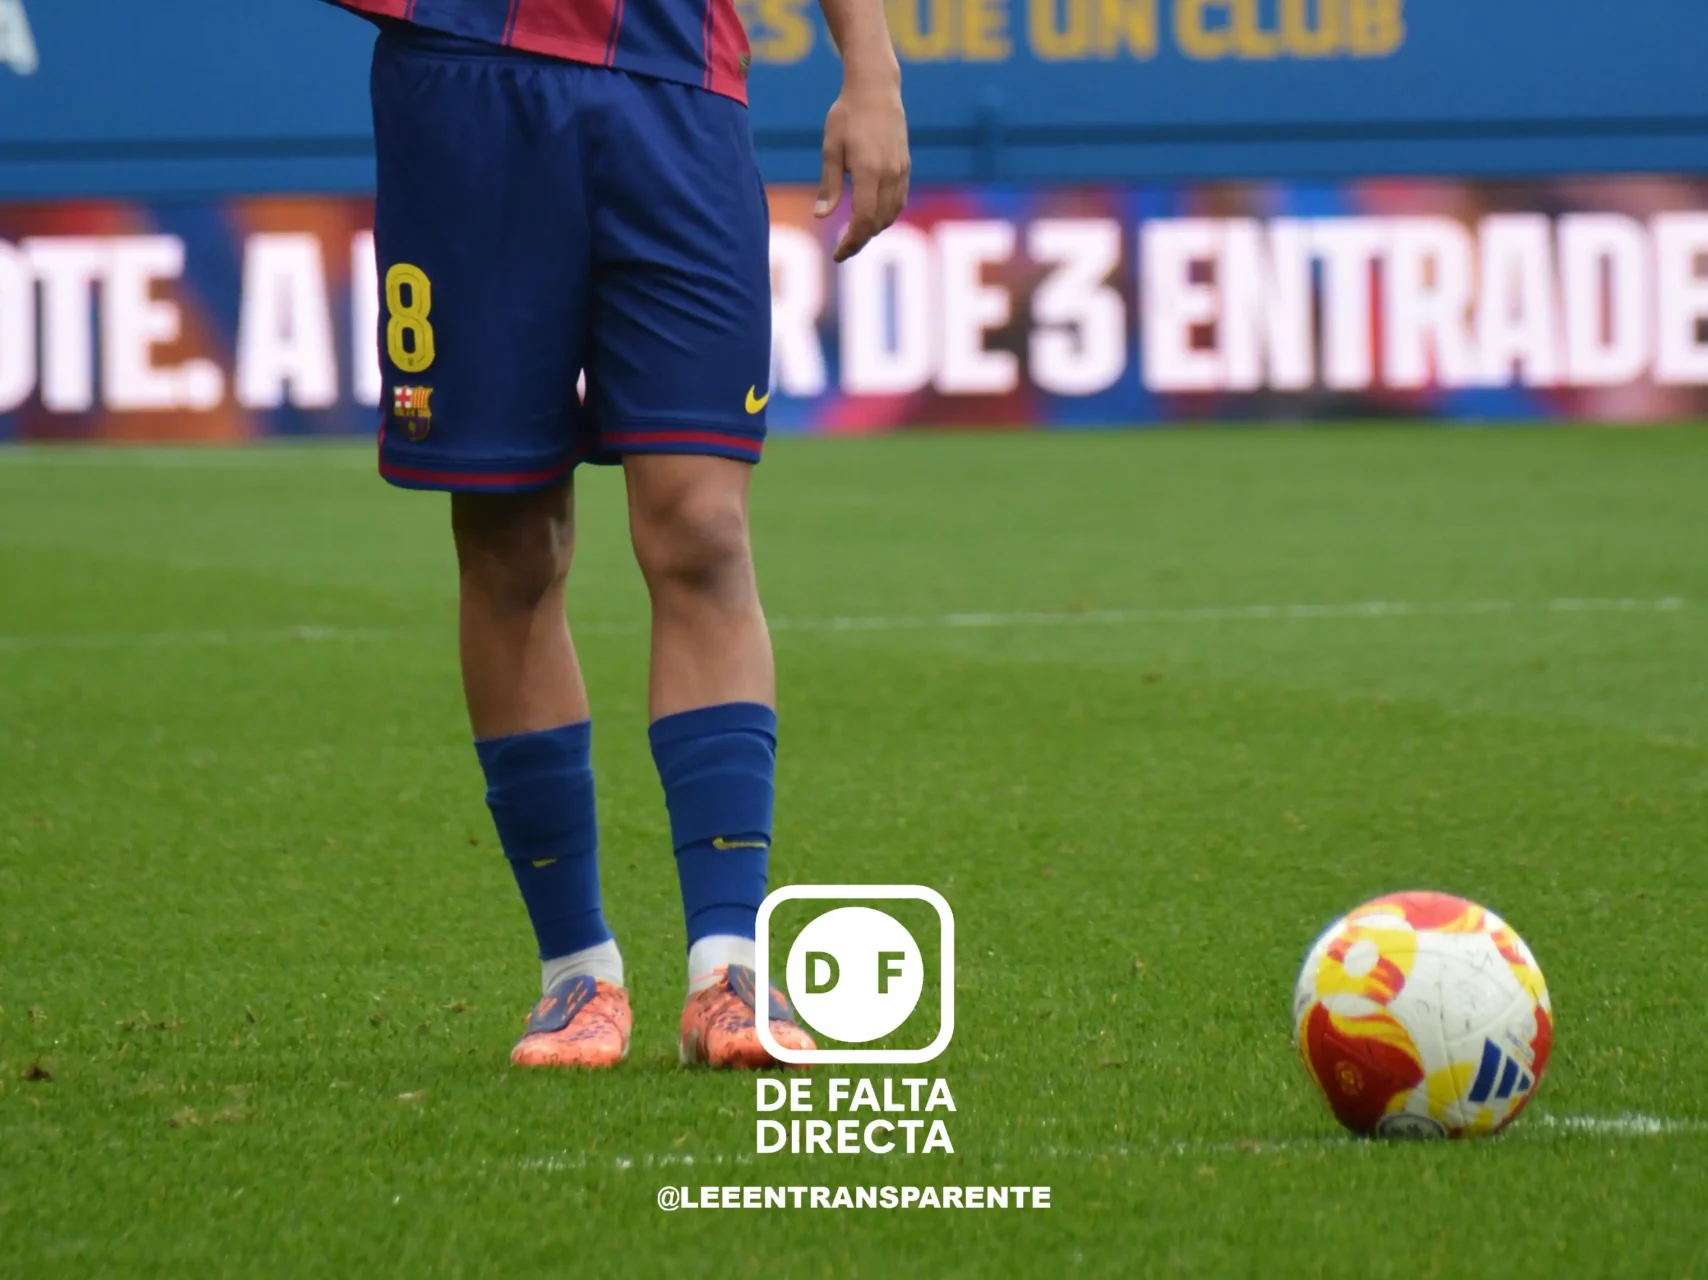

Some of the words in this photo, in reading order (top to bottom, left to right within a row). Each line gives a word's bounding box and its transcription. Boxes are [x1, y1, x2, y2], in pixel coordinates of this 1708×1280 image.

[234, 231, 339, 410] A
[386, 263, 436, 373] 8
[836, 218, 1019, 395] DE
[1027, 217, 1128, 395] 3
